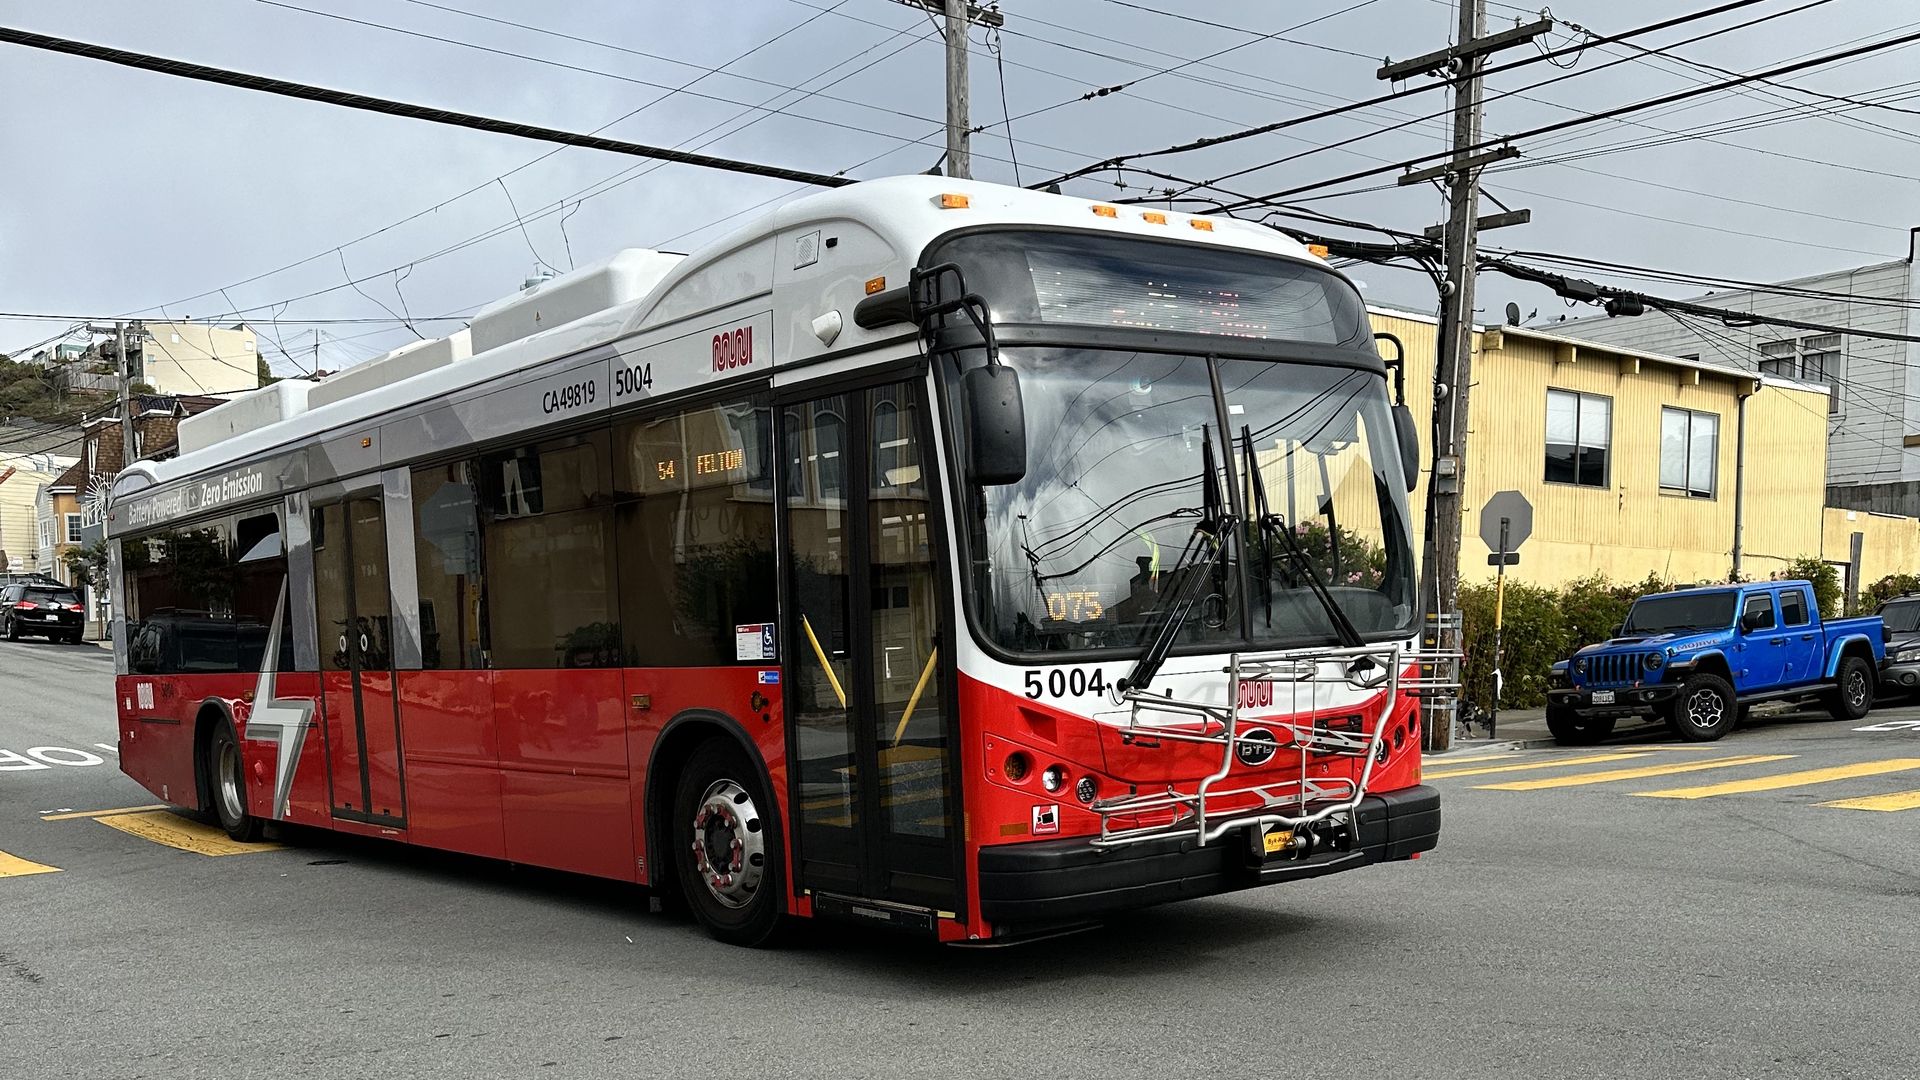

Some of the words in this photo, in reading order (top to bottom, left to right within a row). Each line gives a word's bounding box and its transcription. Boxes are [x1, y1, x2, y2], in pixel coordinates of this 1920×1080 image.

[616, 363, 653, 396] 5004
[543, 380, 596, 414] CA49819
[658, 460, 675, 481] 54
[697, 448, 744, 475] FELTON
[128, 501, 150, 526] Battery
[151, 488, 183, 520] Powered
[201, 483, 221, 507] Zero
[222, 467, 263, 500] Emission
[1048, 591, 1103, 621] 075
[1025, 668, 1106, 699] 5004
